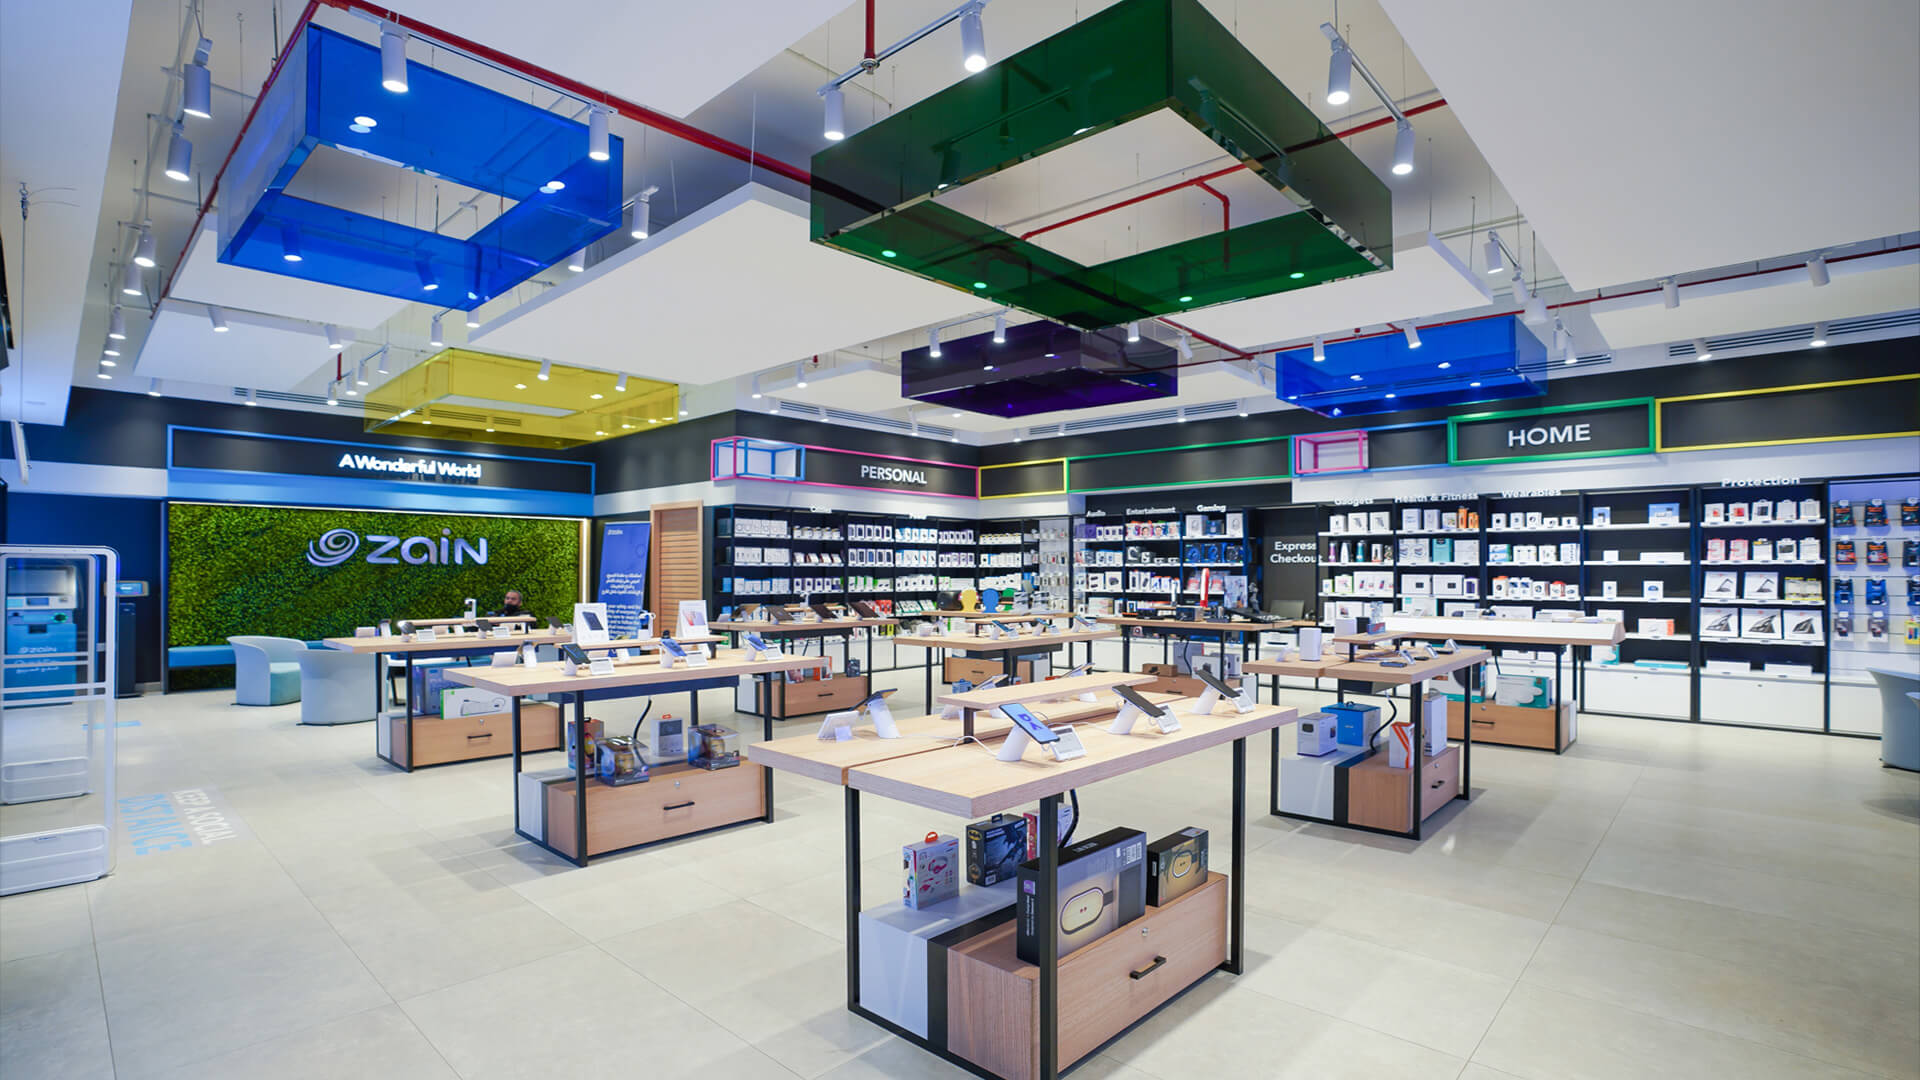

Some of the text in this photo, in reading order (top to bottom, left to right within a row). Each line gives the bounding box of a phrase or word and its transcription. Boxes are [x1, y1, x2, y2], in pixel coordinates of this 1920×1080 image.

[1508, 424, 1591, 447] HOME
[339, 453, 482, 478] A Wonderful World
[861, 465, 928, 484] PERSONAL
[1721, 476, 1801, 487] Protection
[1126, 506, 1176, 515] Entertainment
[1196, 504, 1226, 512] Gaming
[1274, 541, 1317, 552] Express
[1270, 553, 1323, 563] Checkout
